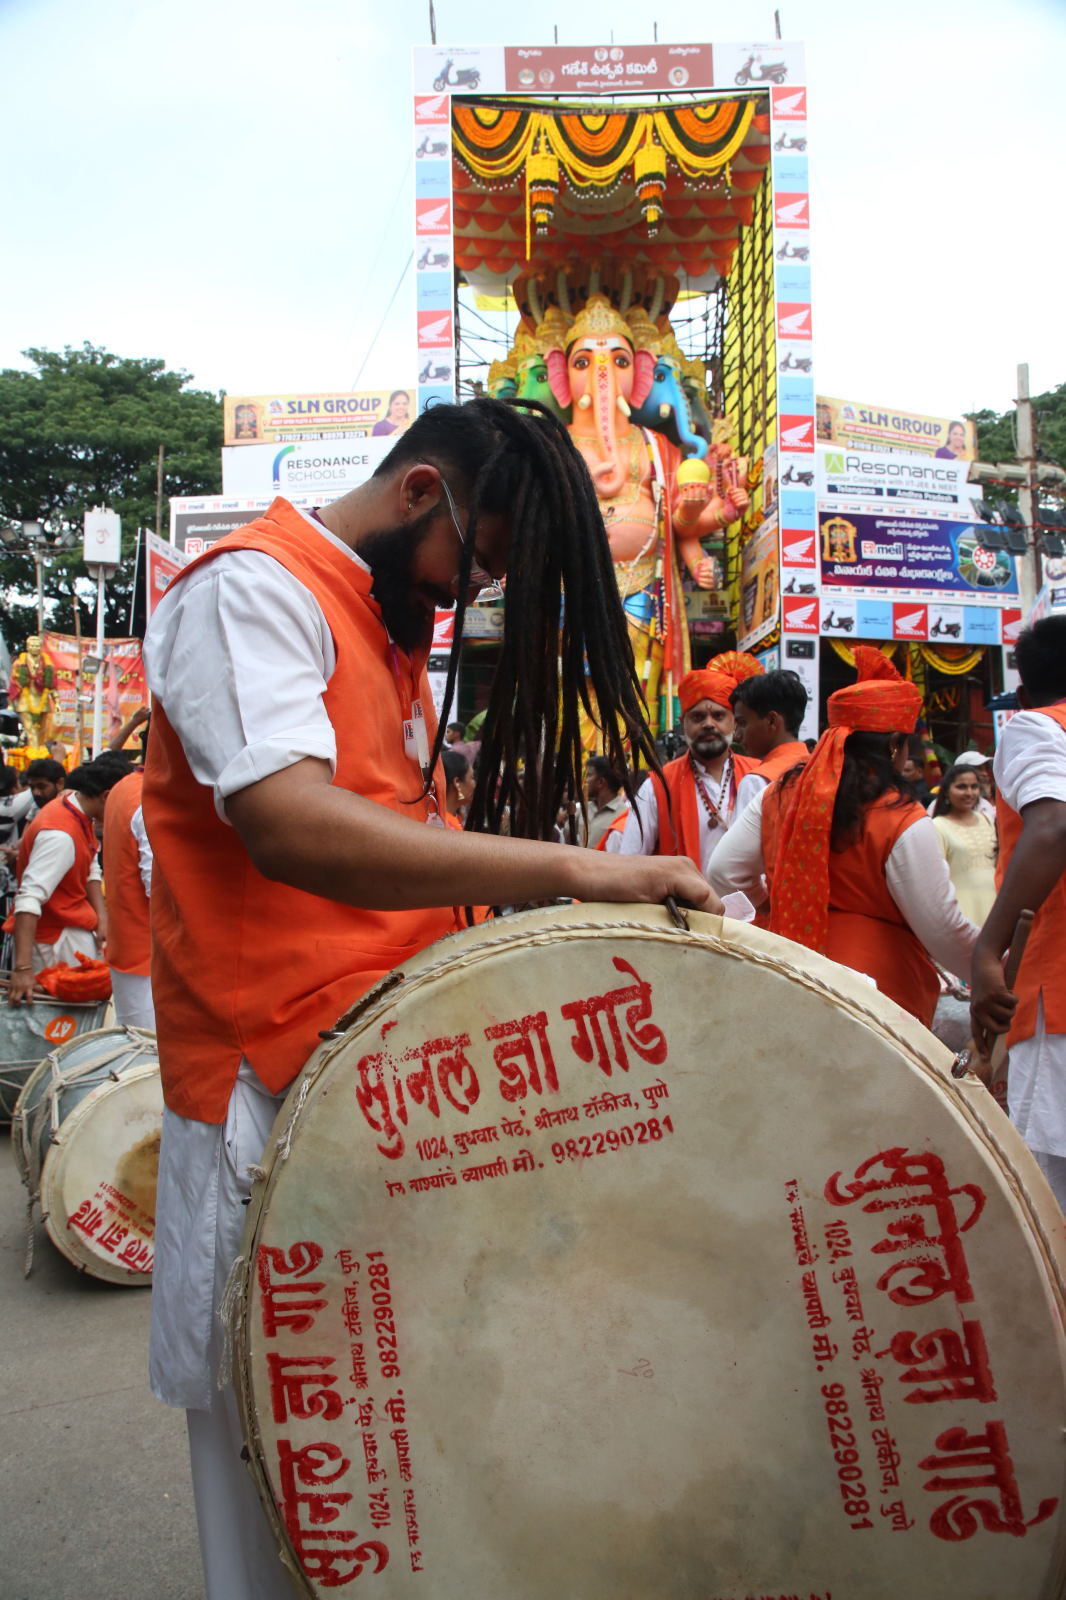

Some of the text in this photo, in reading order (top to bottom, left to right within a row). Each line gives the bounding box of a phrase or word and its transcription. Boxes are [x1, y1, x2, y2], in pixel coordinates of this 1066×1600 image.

[287, 397, 382, 414] SLN GROUP
[859, 410, 889, 428] SLN
[891, 417, 942, 437] GROUP
[287, 455, 369, 469] RESONANCE
[287, 468, 346, 482] SCHOOLS
[845, 456, 958, 482] Resonance
[876, 543, 902, 555] meil
[785, 622, 817, 630] HONDA
[560, 956, 668, 1077] गाडे
[415, 1136, 454, 1160] 1024,
[453, 1126, 500, 1155] बुधवार
[533, 1106, 580, 1130] श्रीनाथ
[641, 1078, 670, 1109] पुणे
[551, 1114, 675, 1163] 982290281
[337, 1249, 360, 1275] पुणे
[824, 1219, 854, 1264] 1024,
[364, 1251, 401, 1378] 982290281
[832, 1265, 864, 1321] बुधवार
[348, 1342, 369, 1389] श्रीनाथ
[823, 1146, 987, 1306] सुनिल
[917, 1420, 1059, 1541] गाडे
[860, 1368, 885, 1421] श्रीनाथ
[361, 1433, 387, 1483] बुधवार
[821, 1382, 872, 1528] 982290281
[368, 1488, 391, 1528] 1024,
[880, 1501, 915, 1530] पुणे
